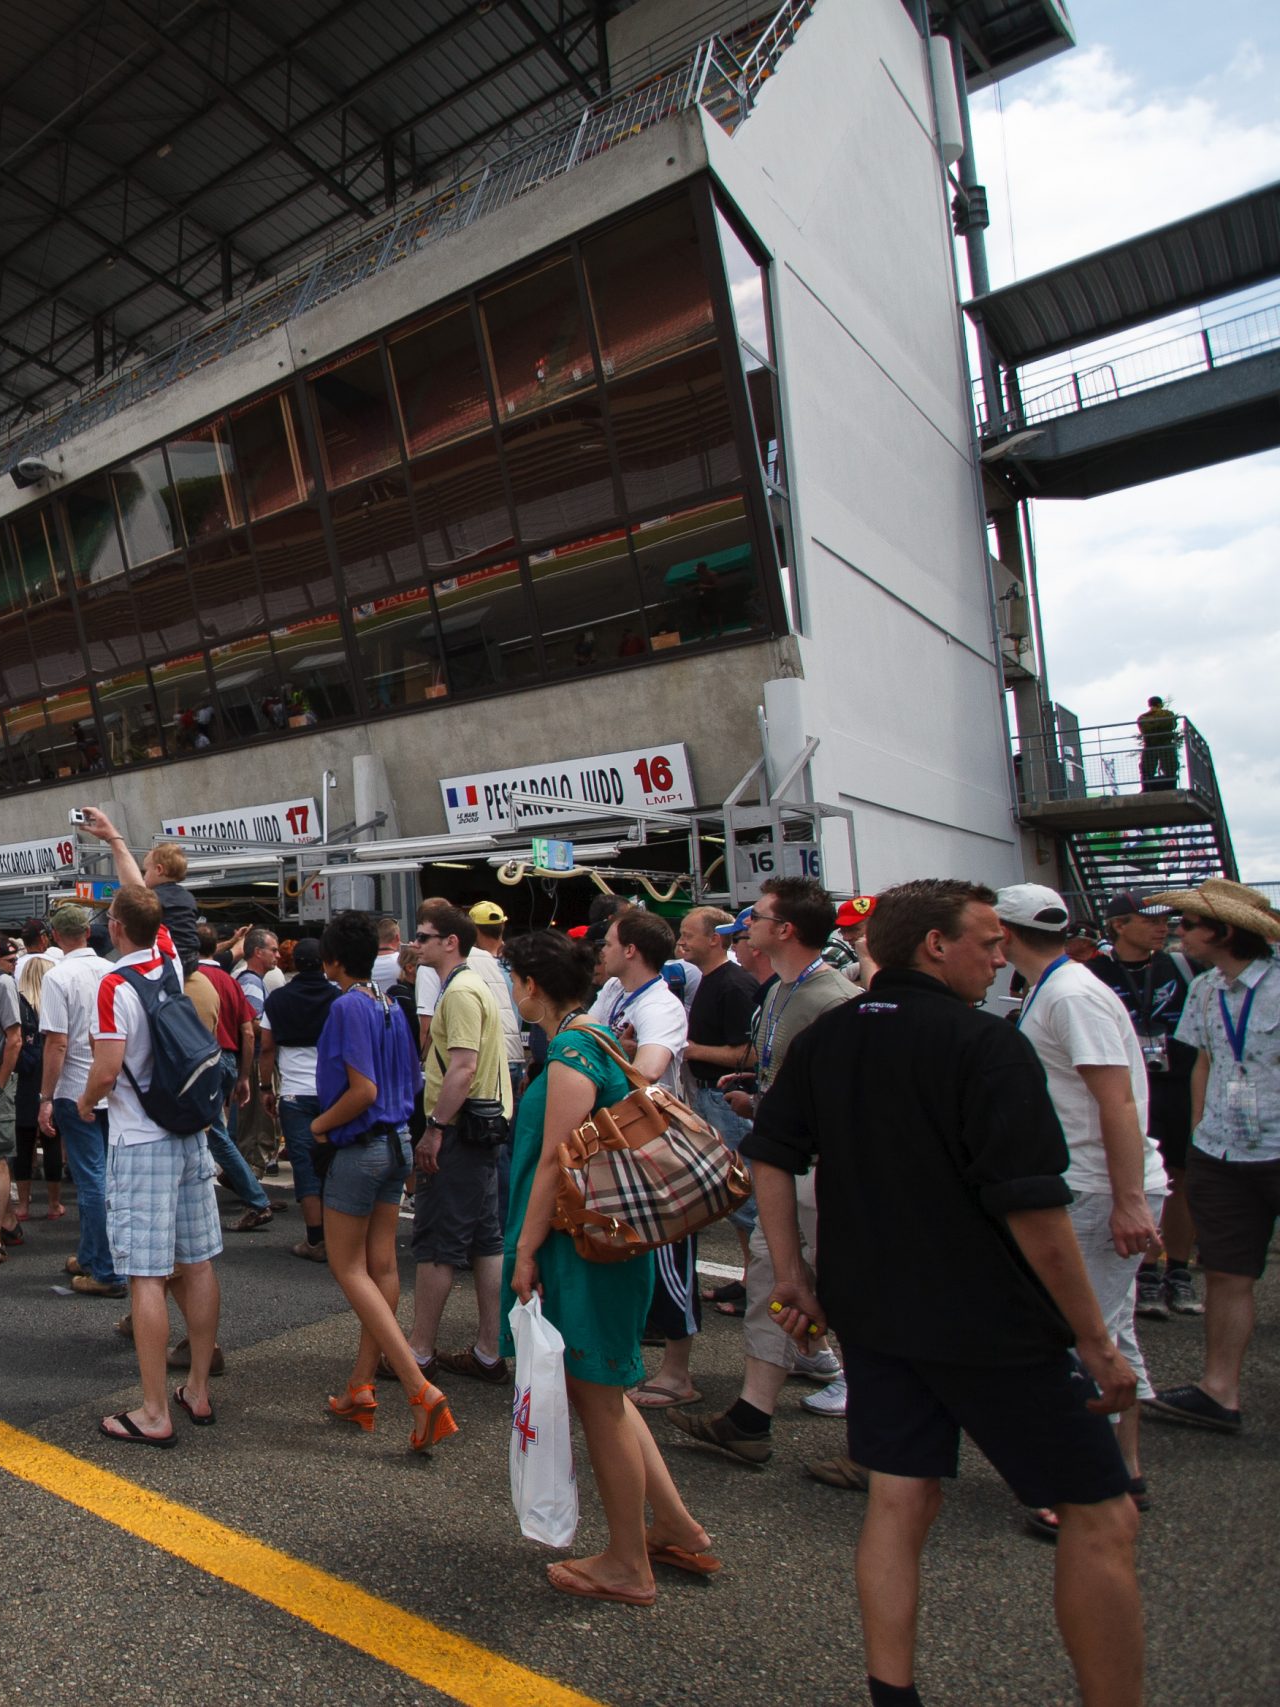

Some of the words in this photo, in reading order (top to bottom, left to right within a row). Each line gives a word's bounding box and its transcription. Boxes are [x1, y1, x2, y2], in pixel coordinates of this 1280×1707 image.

[633, 755, 673, 794] 16
[645, 792, 683, 806] LMP1
[285, 805, 309, 835] 17
[56, 841, 73, 865] 18
[749, 850, 774, 873] 16
[799, 849, 820, 877] 16
[78, 883, 92, 899] 17
